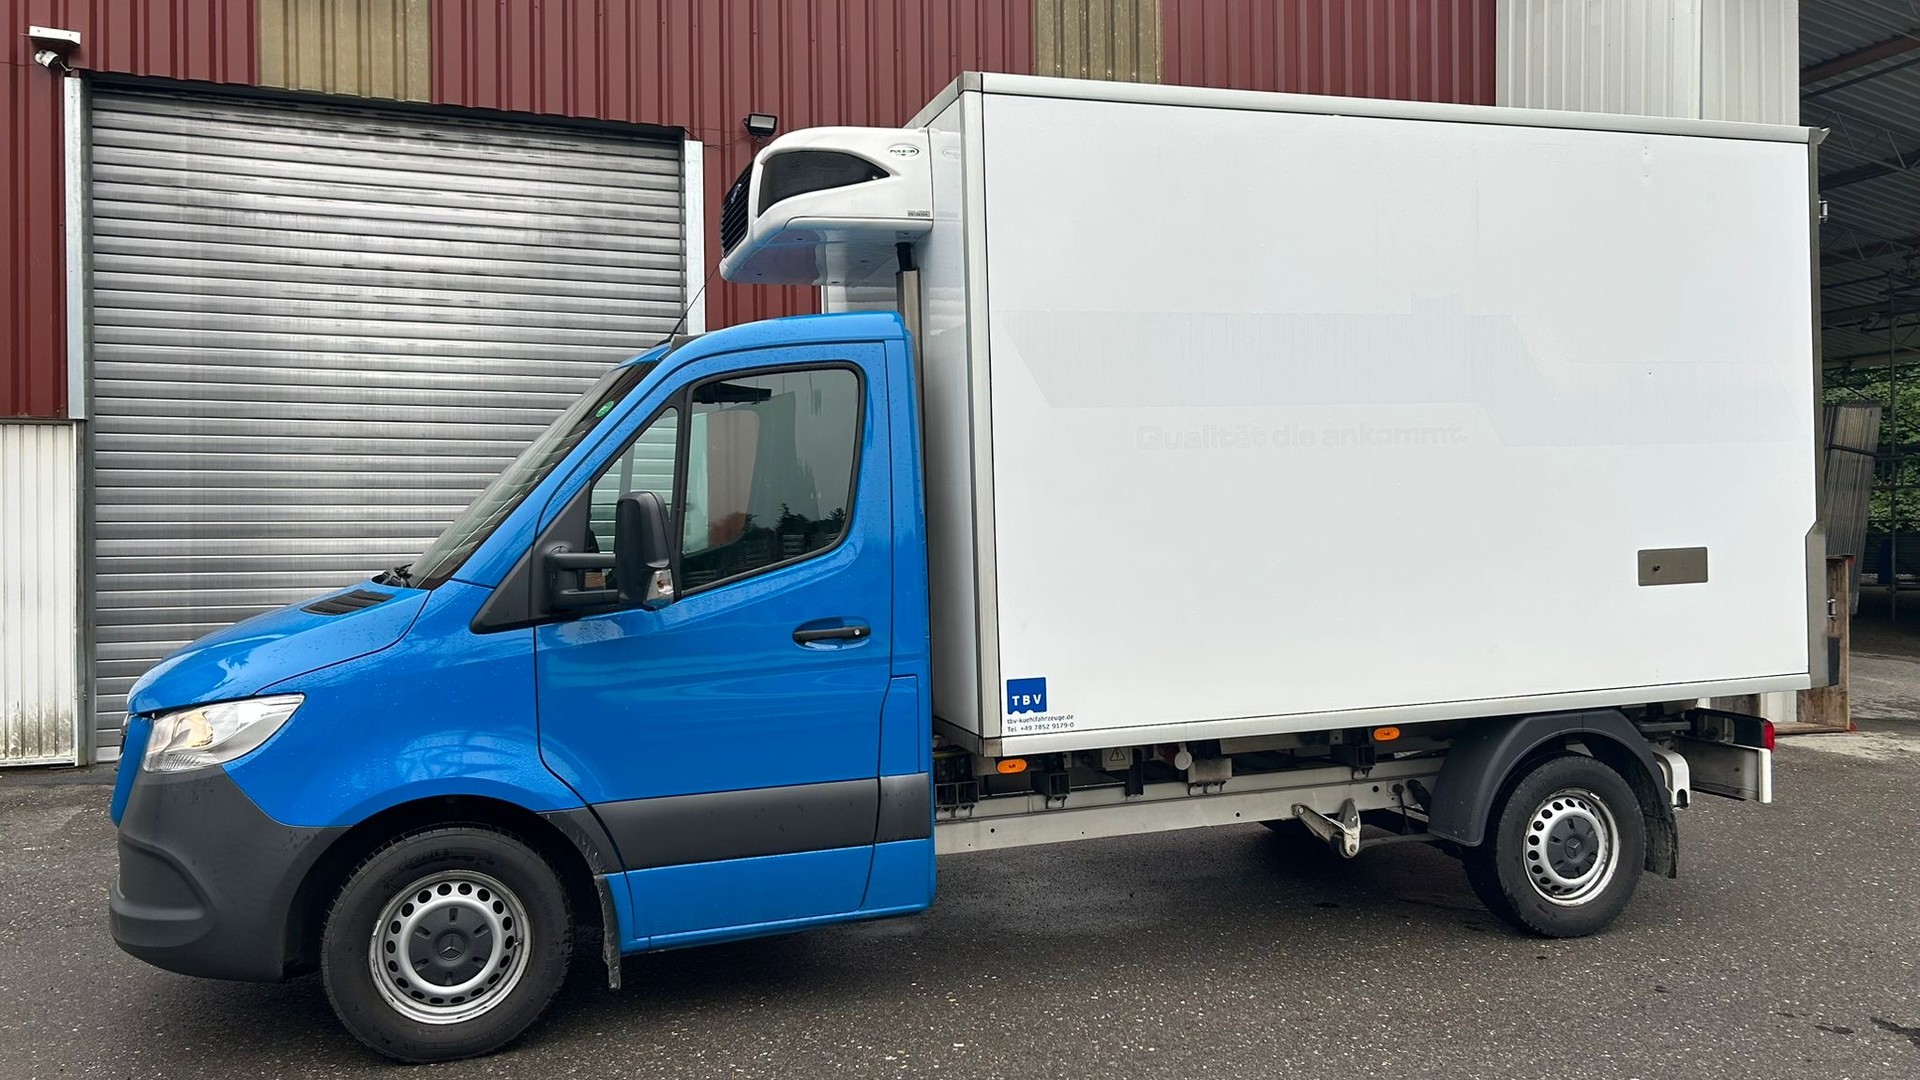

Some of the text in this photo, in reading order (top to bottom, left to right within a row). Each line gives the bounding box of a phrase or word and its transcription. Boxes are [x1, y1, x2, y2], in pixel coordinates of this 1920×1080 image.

[1136, 424, 1265, 451] Qualität
[1272, 423, 1316, 448] die
[1011, 694, 1042, 706] TBV
